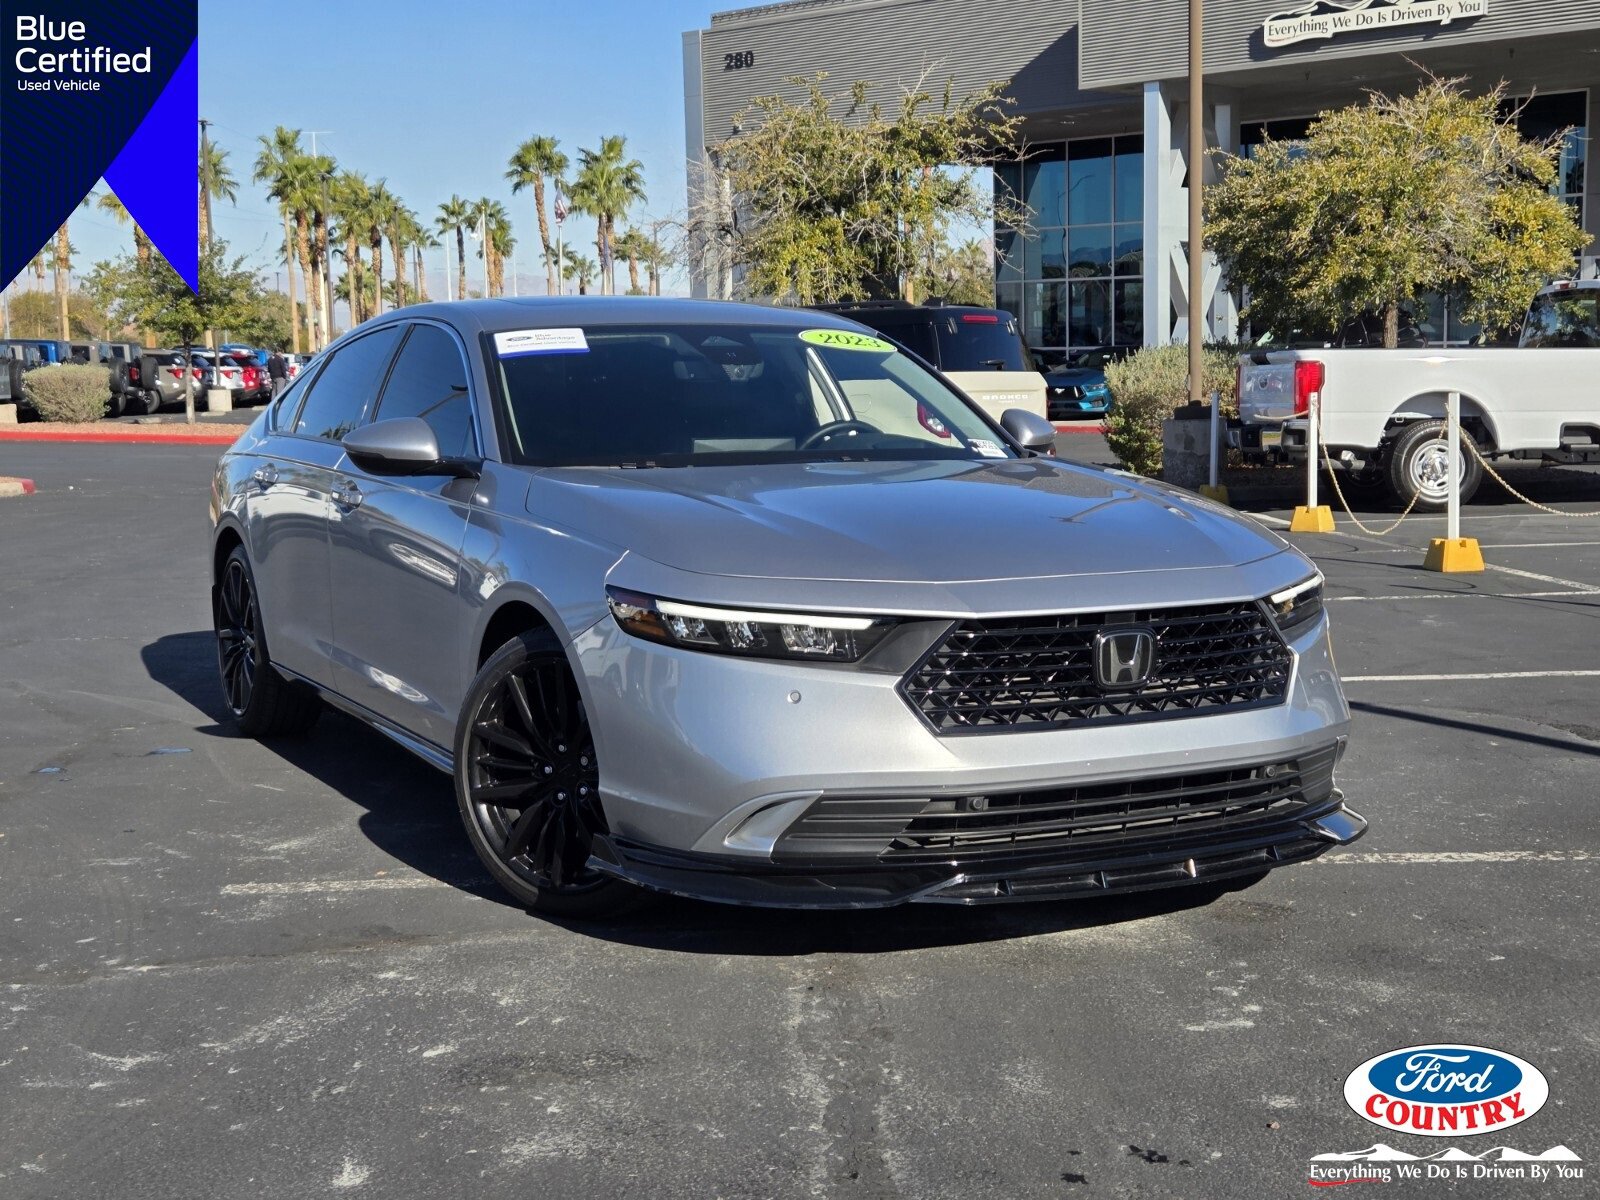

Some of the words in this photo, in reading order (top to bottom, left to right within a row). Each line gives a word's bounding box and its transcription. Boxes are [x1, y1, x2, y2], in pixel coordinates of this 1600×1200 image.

[1268, 19, 1328, 37] Everything
[1333, 16, 1351, 29] We
[1356, 14, 1373, 26] Do
[1377, 12, 1387, 23] Is
[1391, 7, 1432, 22] Driven
[1438, 4, 1453, 18] By
[1458, 1, 1481, 13] You
[724, 50, 754, 71] 280
[819, 333, 881, 348] 2023
